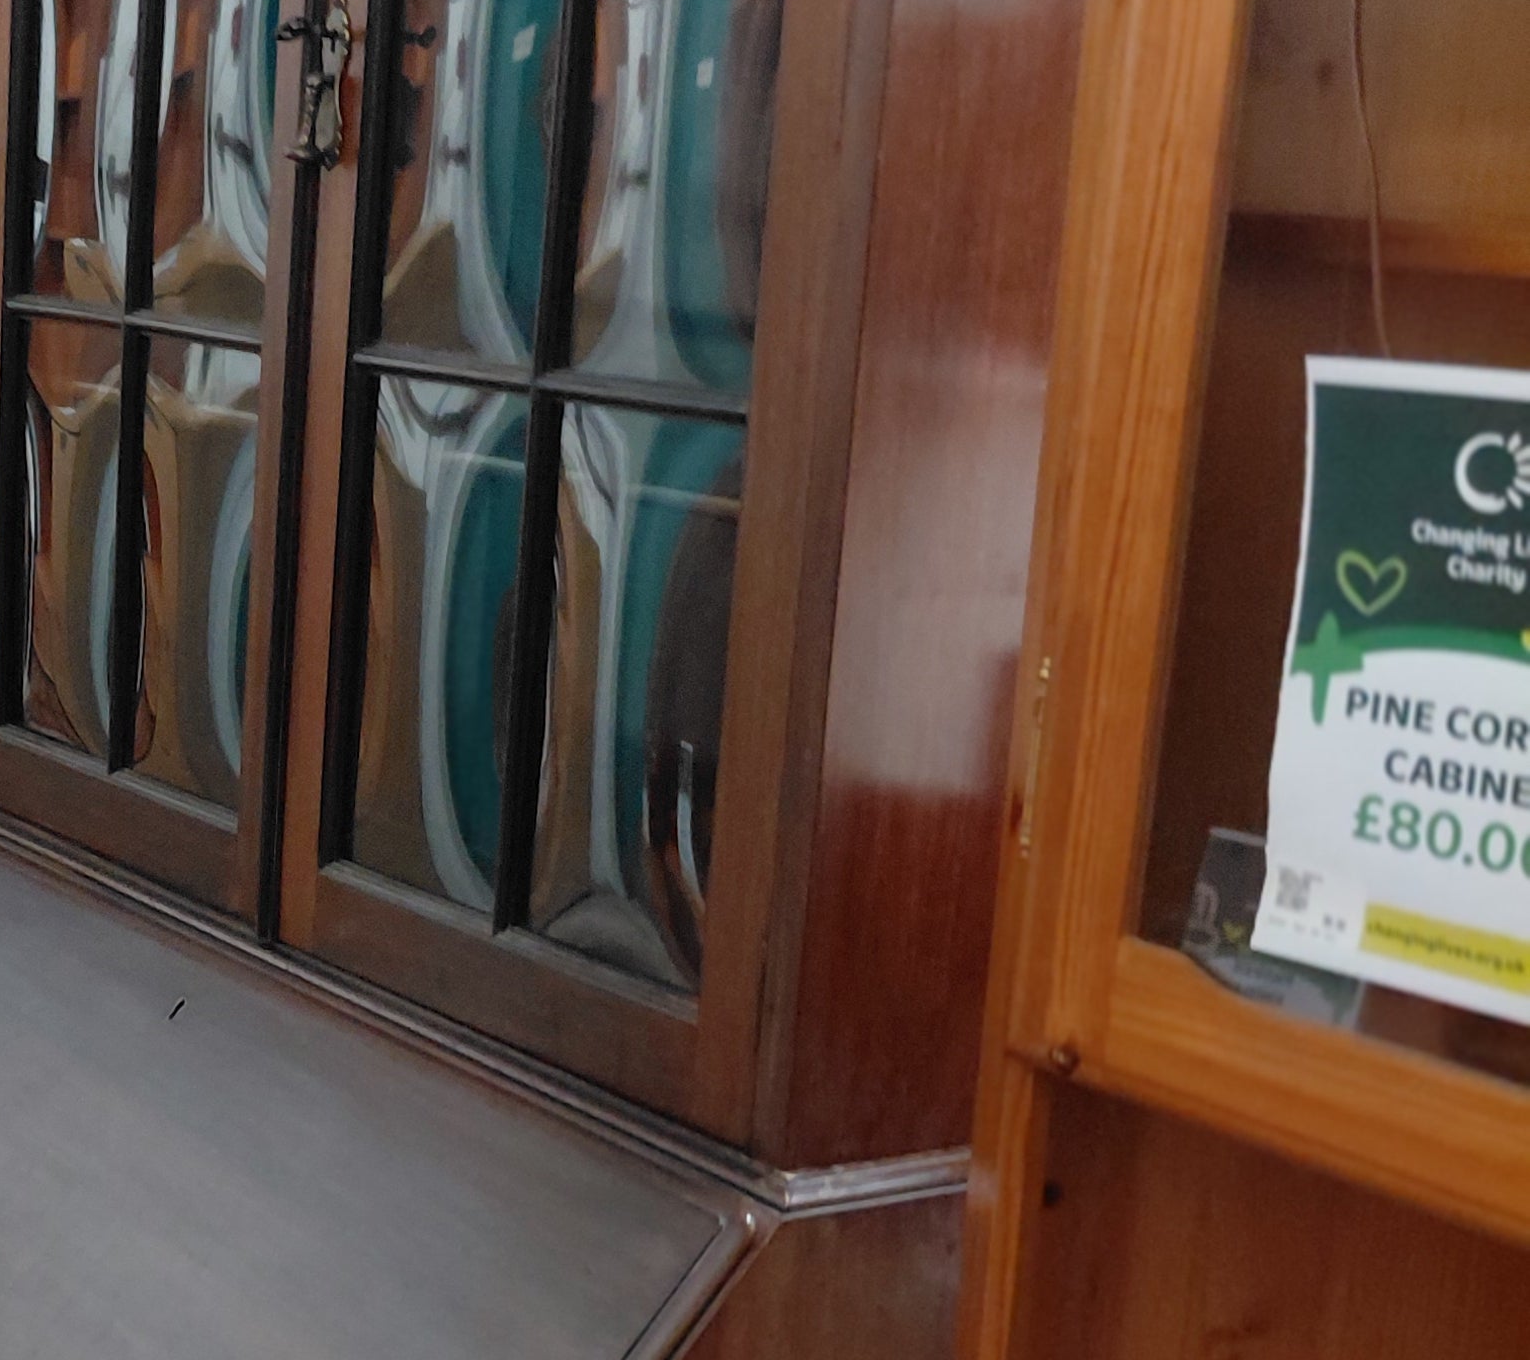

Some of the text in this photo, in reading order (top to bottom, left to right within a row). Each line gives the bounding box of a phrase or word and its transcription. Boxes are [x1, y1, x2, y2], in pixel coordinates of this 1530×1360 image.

[1411, 517, 1510, 561] Changing
[1446, 553, 1526, 594] Charity
[1346, 685, 1530, 753] PINE COR
[1384, 748, 1530, 810] CABINE
